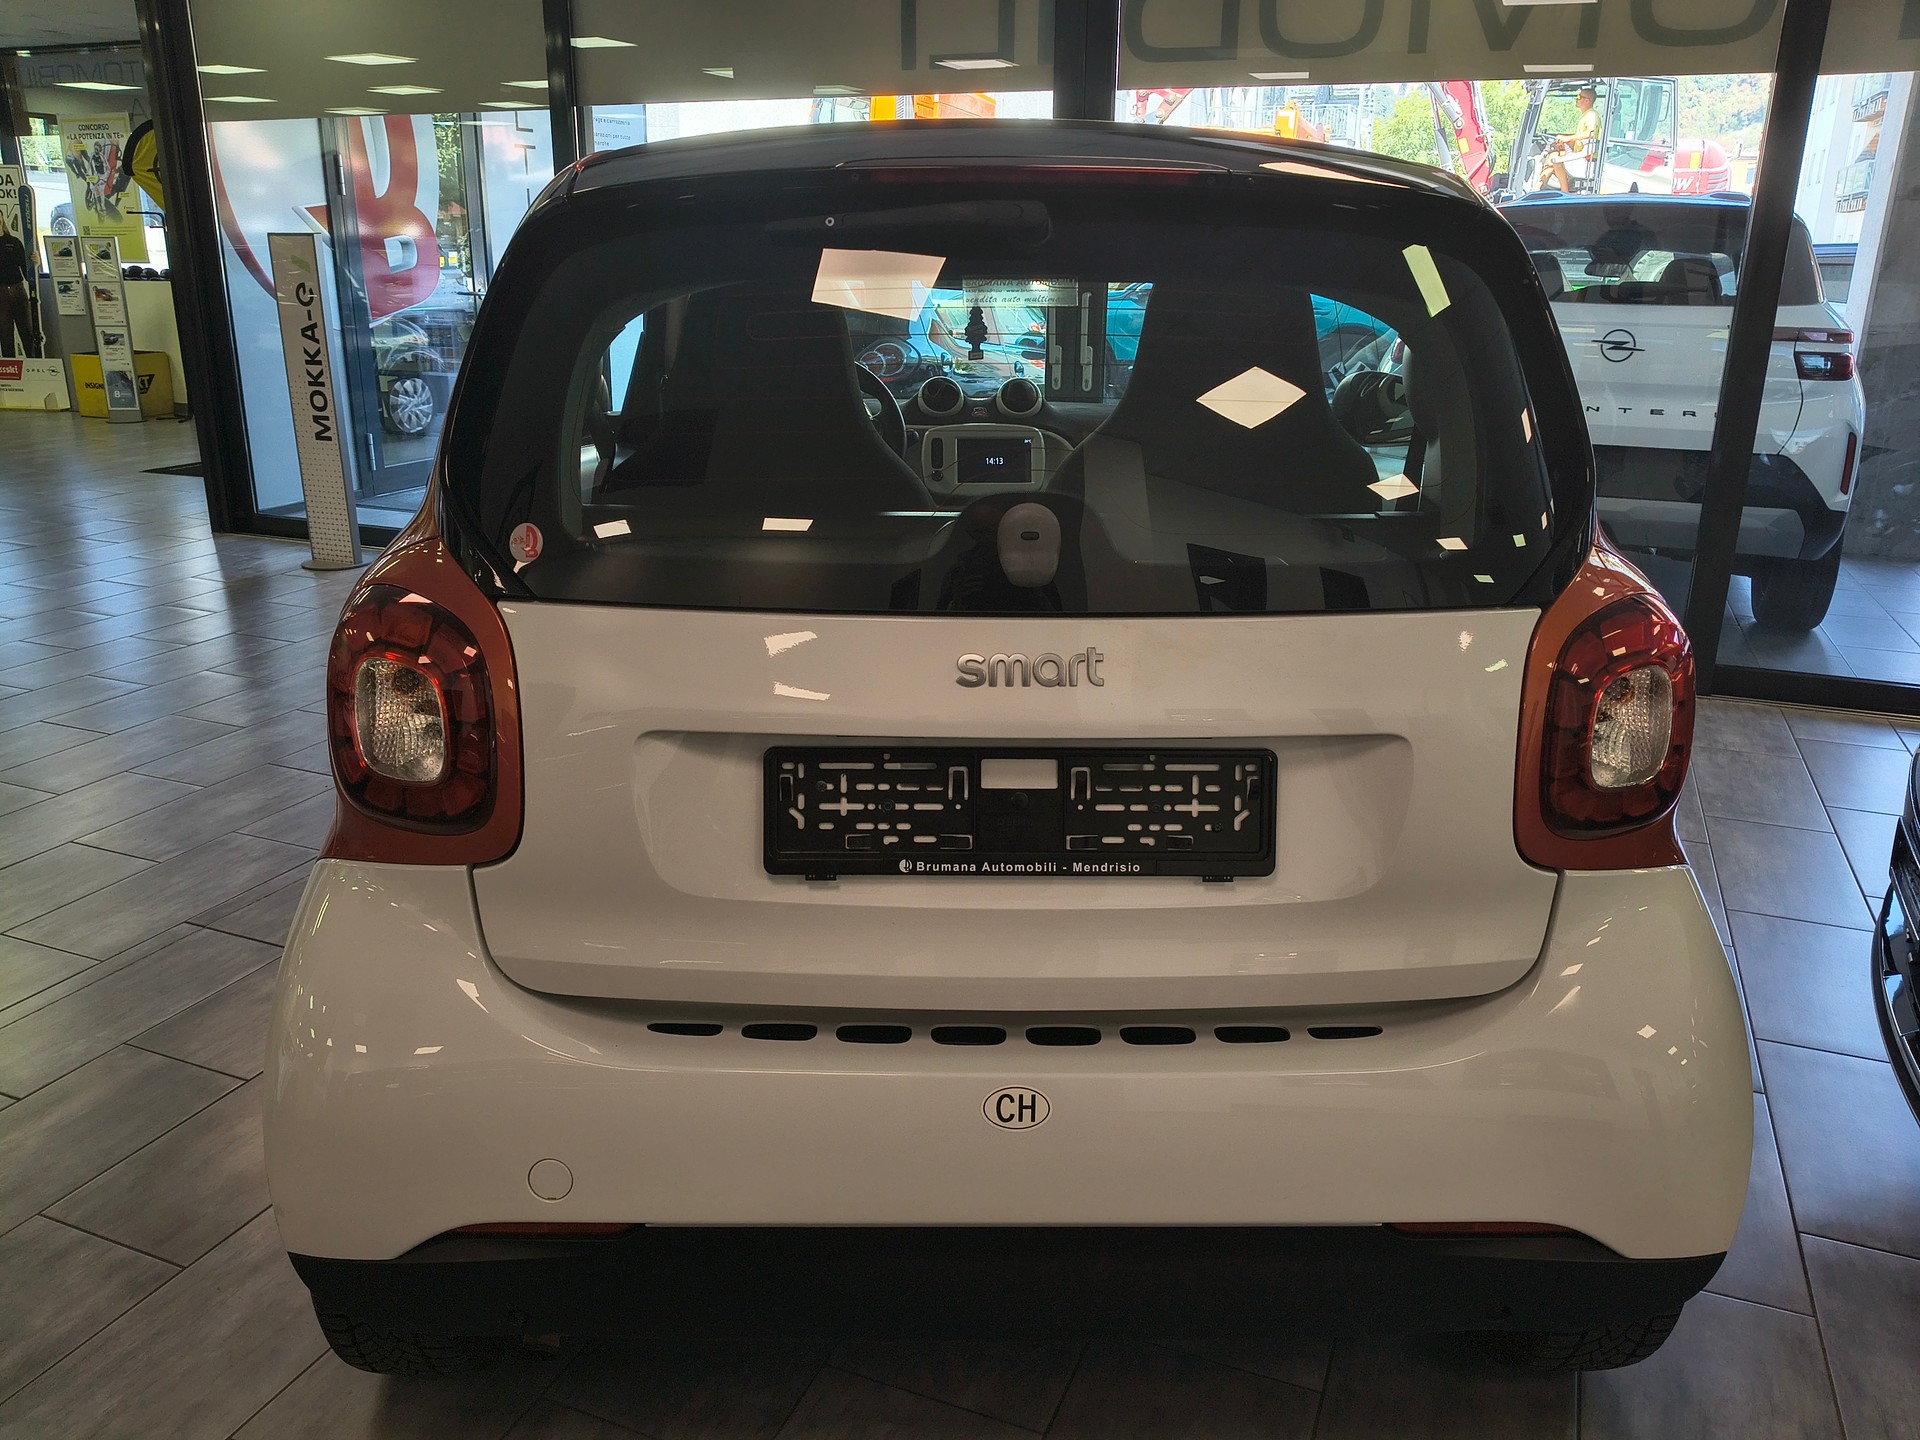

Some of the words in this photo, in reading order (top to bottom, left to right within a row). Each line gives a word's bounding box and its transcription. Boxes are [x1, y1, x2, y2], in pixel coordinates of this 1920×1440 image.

[965, 294, 997, 303] vendita
[1586, 405, 1717, 418] NTER
[985, 457, 1004, 465] 14:13
[956, 647, 1104, 687] smart
[916, 861, 977, 872] Brumana
[981, 861, 1057, 872] Automobili
[1072, 862, 1141, 873] Mendrisio
[996, 1093, 1036, 1123] CH
